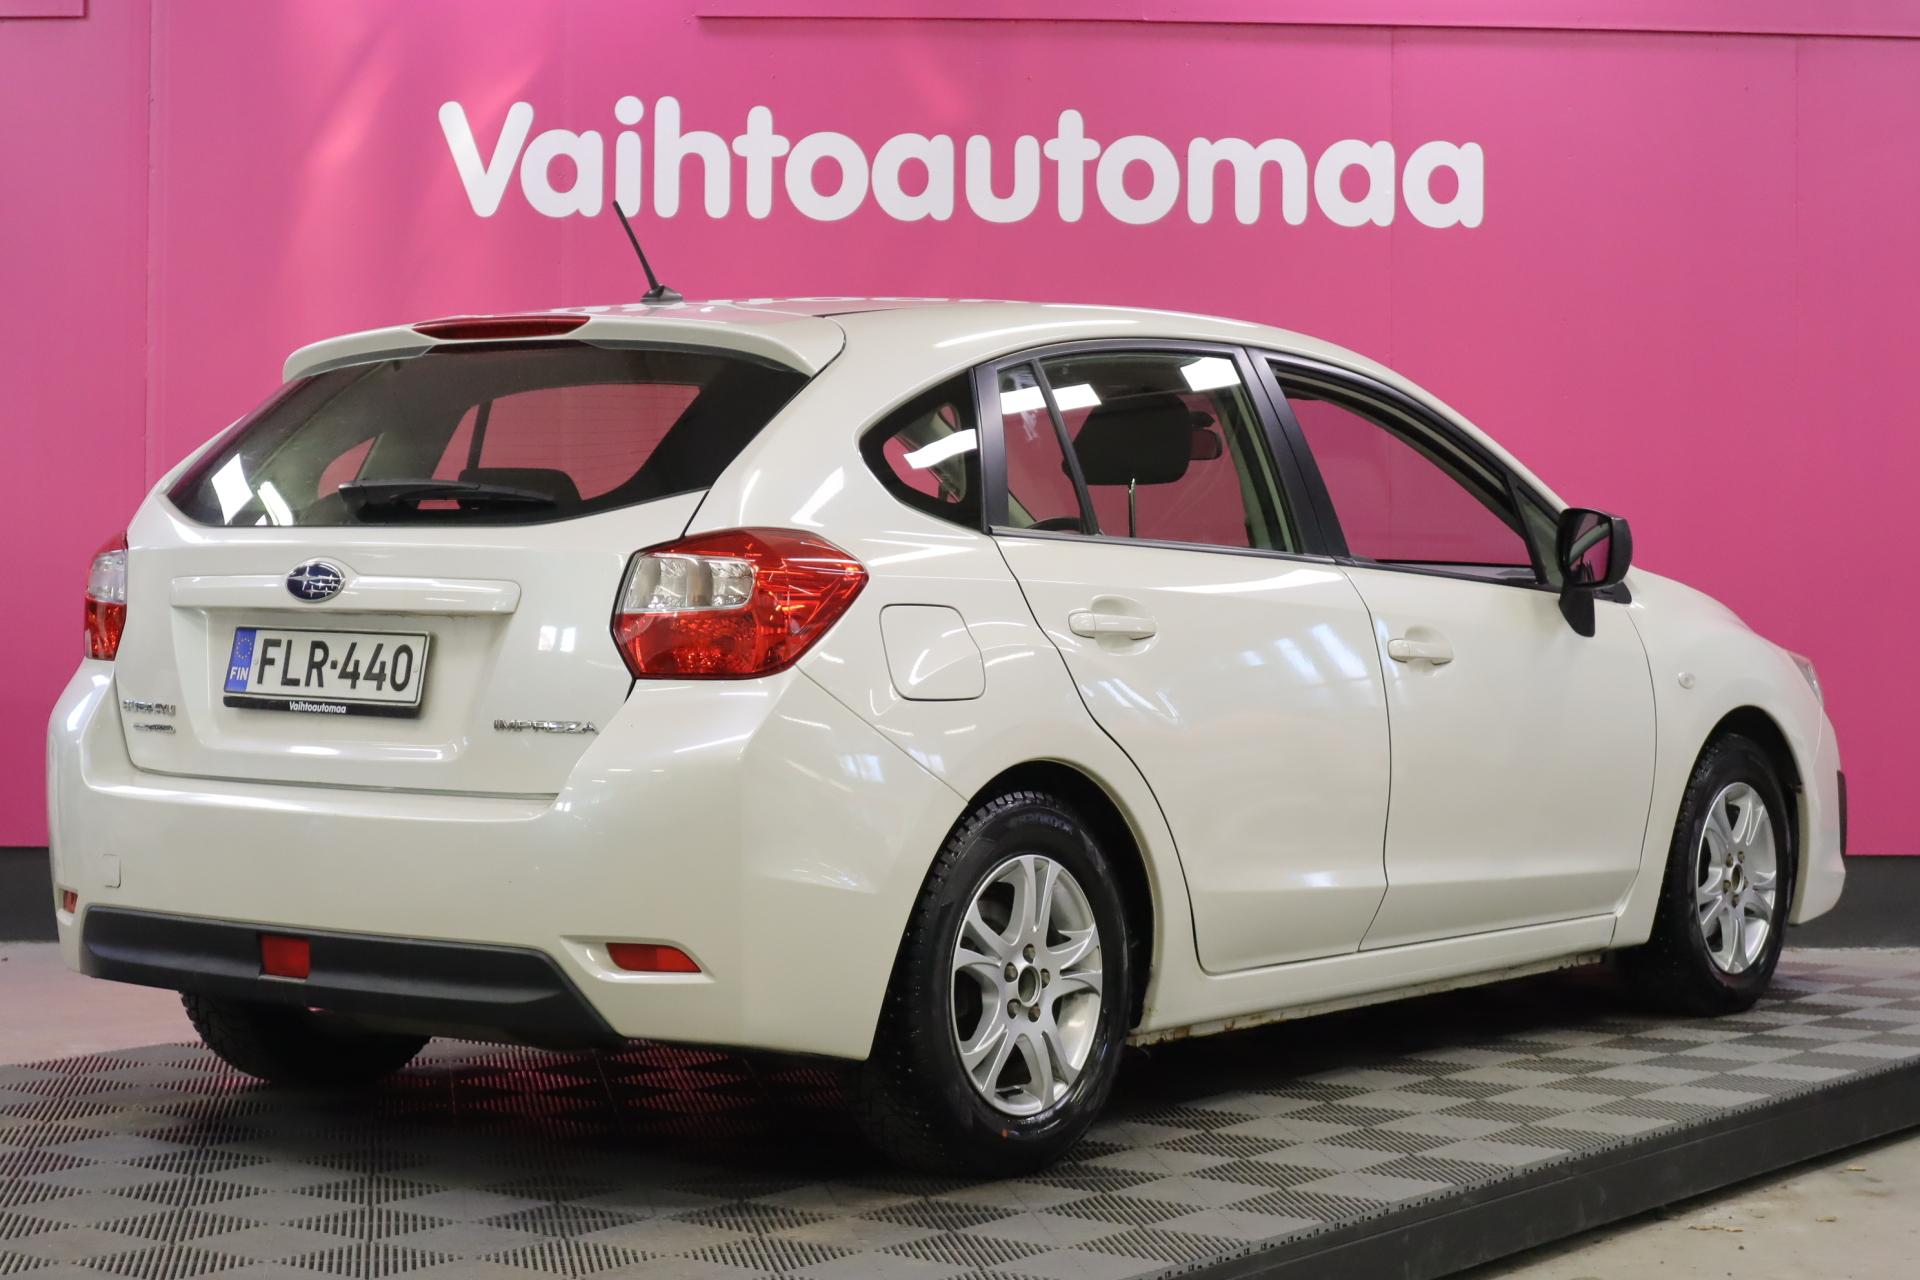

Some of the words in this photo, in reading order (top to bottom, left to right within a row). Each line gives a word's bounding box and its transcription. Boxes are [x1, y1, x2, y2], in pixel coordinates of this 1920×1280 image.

[438, 95, 1484, 229] Vaihtoautomaa
[229, 666, 249, 681] FIN
[256, 638, 414, 692] FLR-440
[289, 700, 347, 714] Vaihtoautomaa
